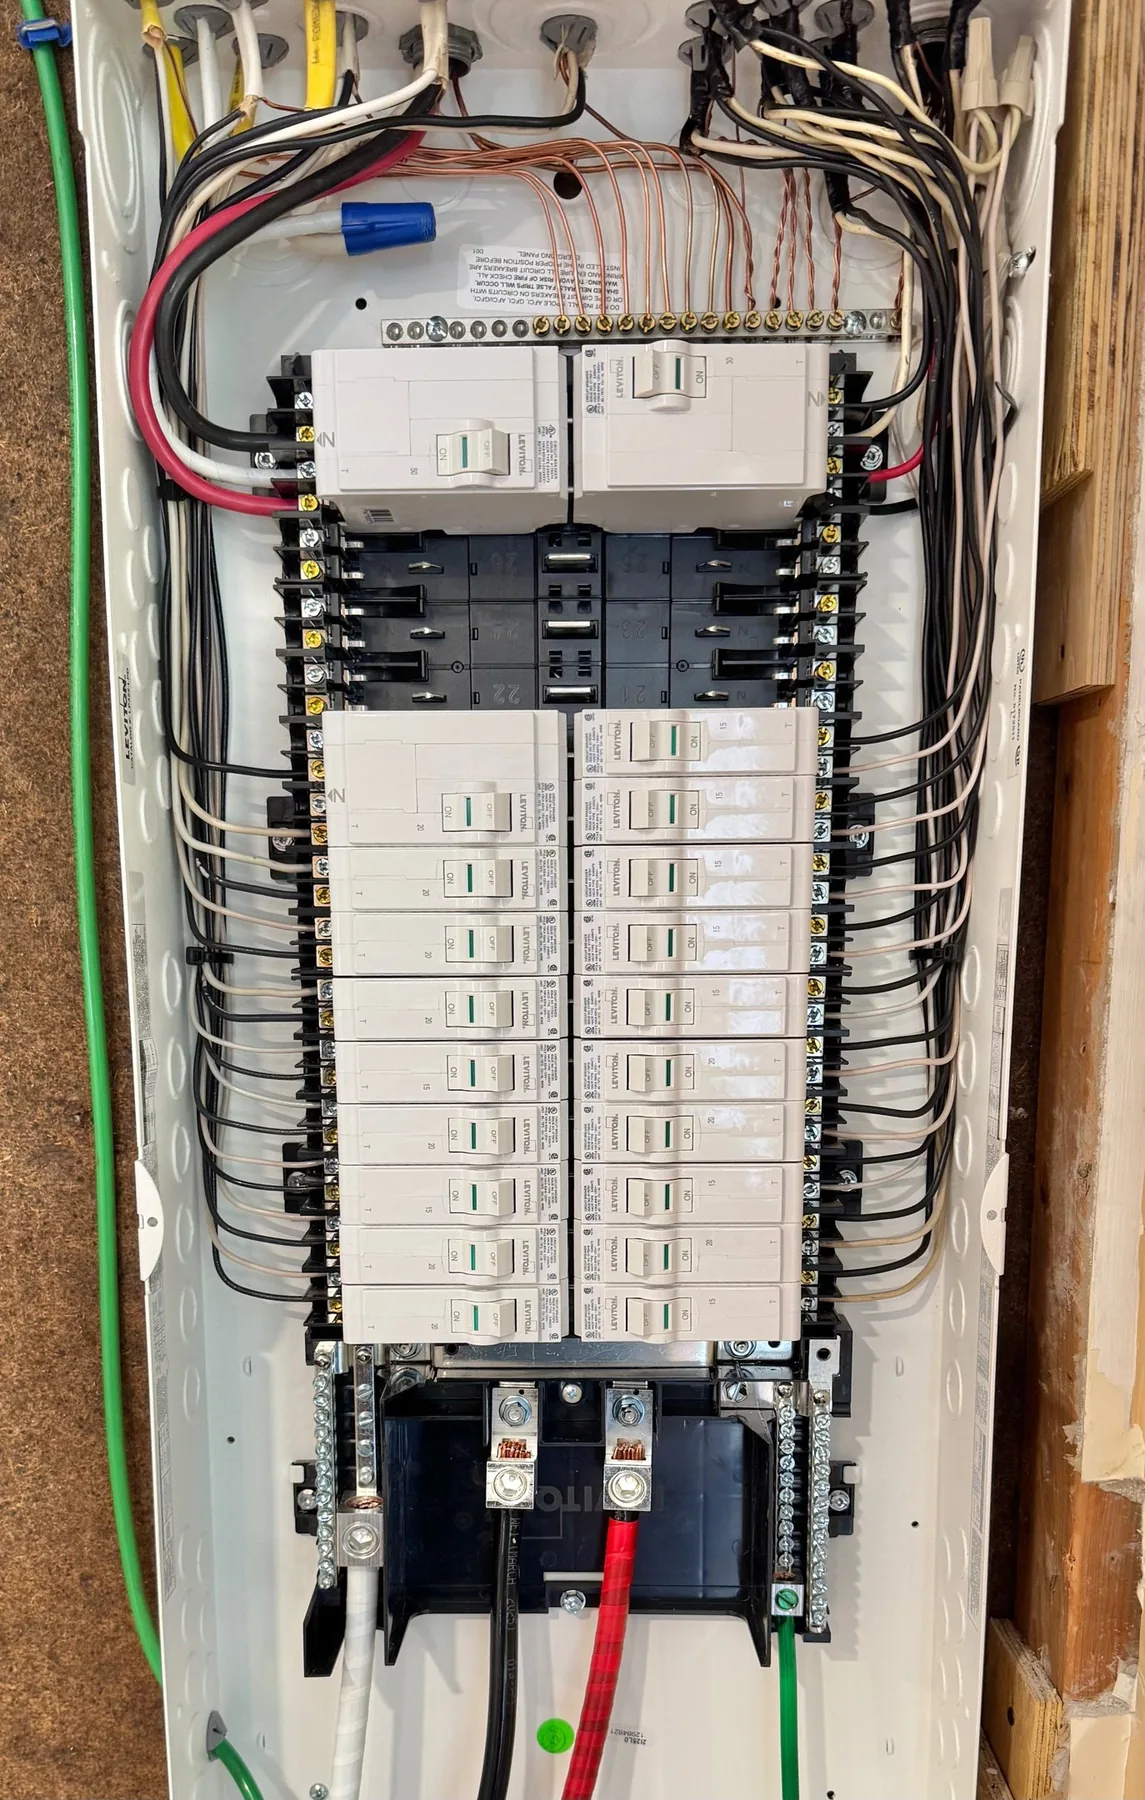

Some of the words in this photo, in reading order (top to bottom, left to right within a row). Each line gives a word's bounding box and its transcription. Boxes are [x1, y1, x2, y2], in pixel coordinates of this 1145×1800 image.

[531, 291, 565, 300] BEAKERS
[696, 371, 703, 384] ON
[439, 448, 447, 460] ON
[492, 684, 520, 705] 22
[120, 677, 130, 759] LEVITON
[690, 736, 698, 748] ON
[445, 806, 452, 818] ON
[690, 804, 697, 815] ON
[447, 872, 454, 884] ON
[689, 872, 696, 884] ON
[447, 938, 455, 949] ON
[688, 937, 695, 948] ON
[448, 1003, 455, 1015] ON
[685, 1002, 692, 1013] ON
[450, 1067, 457, 1078] ON
[685, 1067, 692, 1078] ON
[451, 1130, 458, 1140] ON
[684, 1128, 690, 1139] ON
[452, 1190, 459, 1201] ON
[684, 1190, 690, 1201] ON
[451, 1251, 458, 1261] ON
[682, 1250, 689, 1261] ON
[453, 1311, 460, 1321] ON
[682, 1310, 689, 1320] ON
